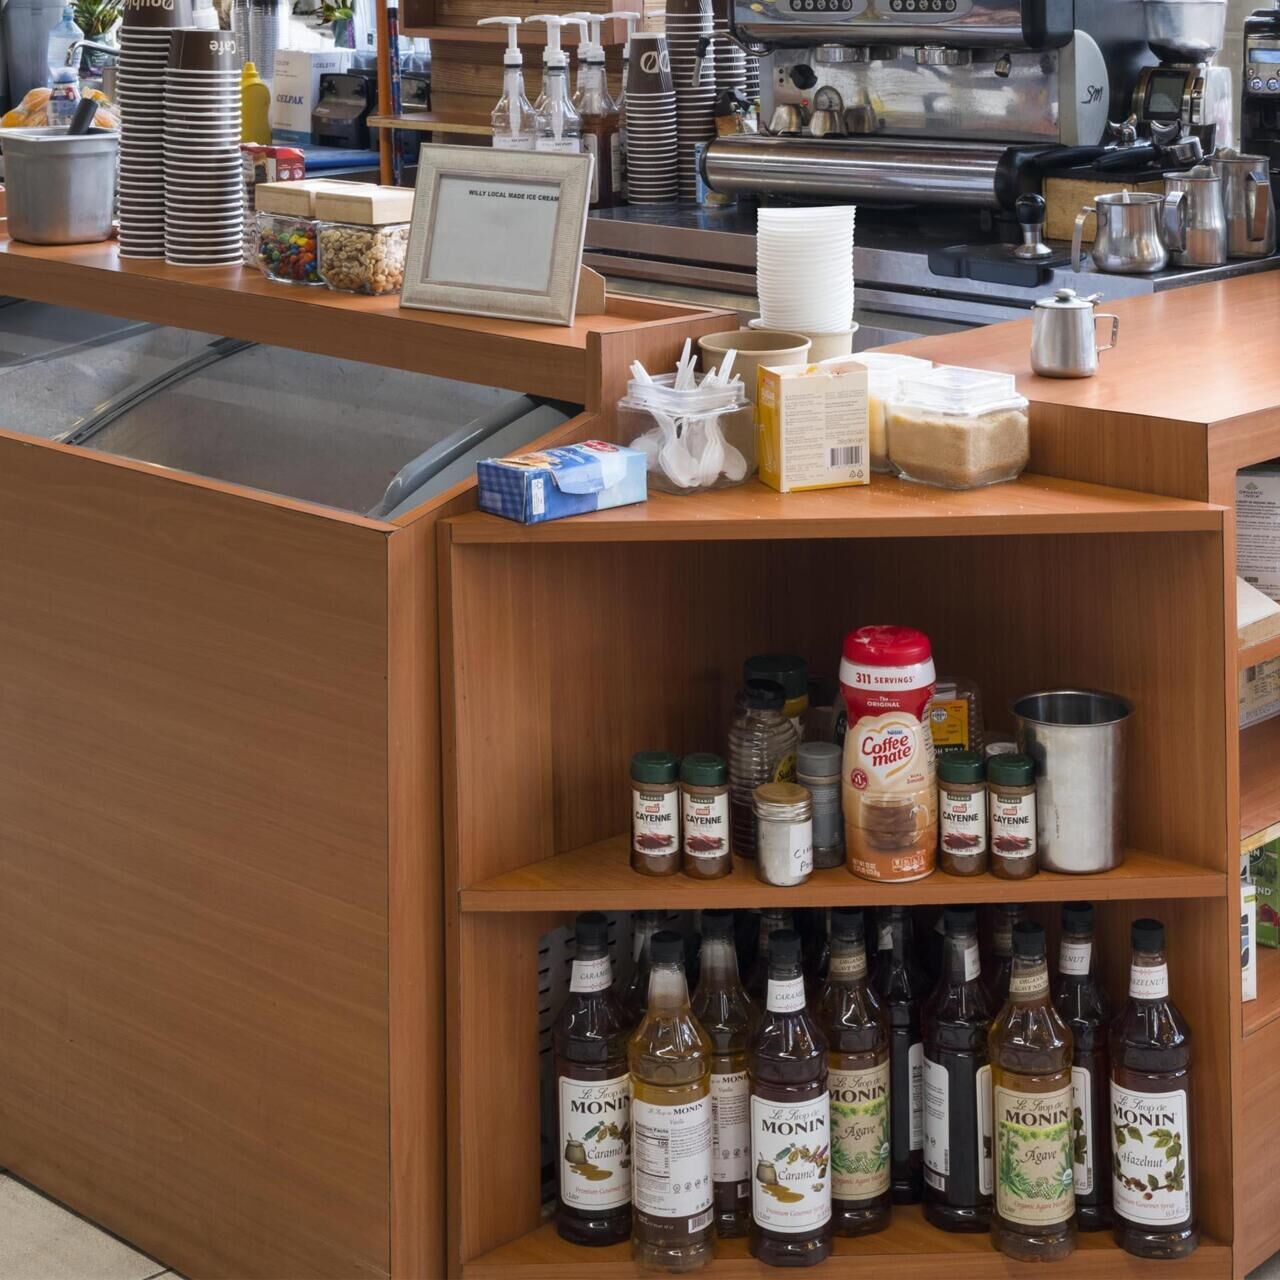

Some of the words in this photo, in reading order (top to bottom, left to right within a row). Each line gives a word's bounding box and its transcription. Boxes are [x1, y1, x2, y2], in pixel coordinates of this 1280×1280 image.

[469, 189, 486, 197] WILLY
[507, 192, 525, 200] MADE
[856, 672, 871, 684] 311
[874, 676, 913, 684] SERVINGS
[862, 735, 909, 756] Coffee
[872, 746, 911, 767] mate
[635, 813, 672, 824] CAYENNE
[686, 814, 722, 825] CAYENNE
[943, 812, 979, 823] CAYENNE
[993, 814, 1029, 825] CAYENNE
[673, 1104, 703, 1116] MONIN
[1113, 1105, 1175, 1126] MONIN
[1005, 1109, 1068, 1126] MONIN
[761, 1115, 826, 1136] MONIN
[1121, 1151, 1164, 1168] Hazelnut
[778, 1166, 815, 1182] Caramel
